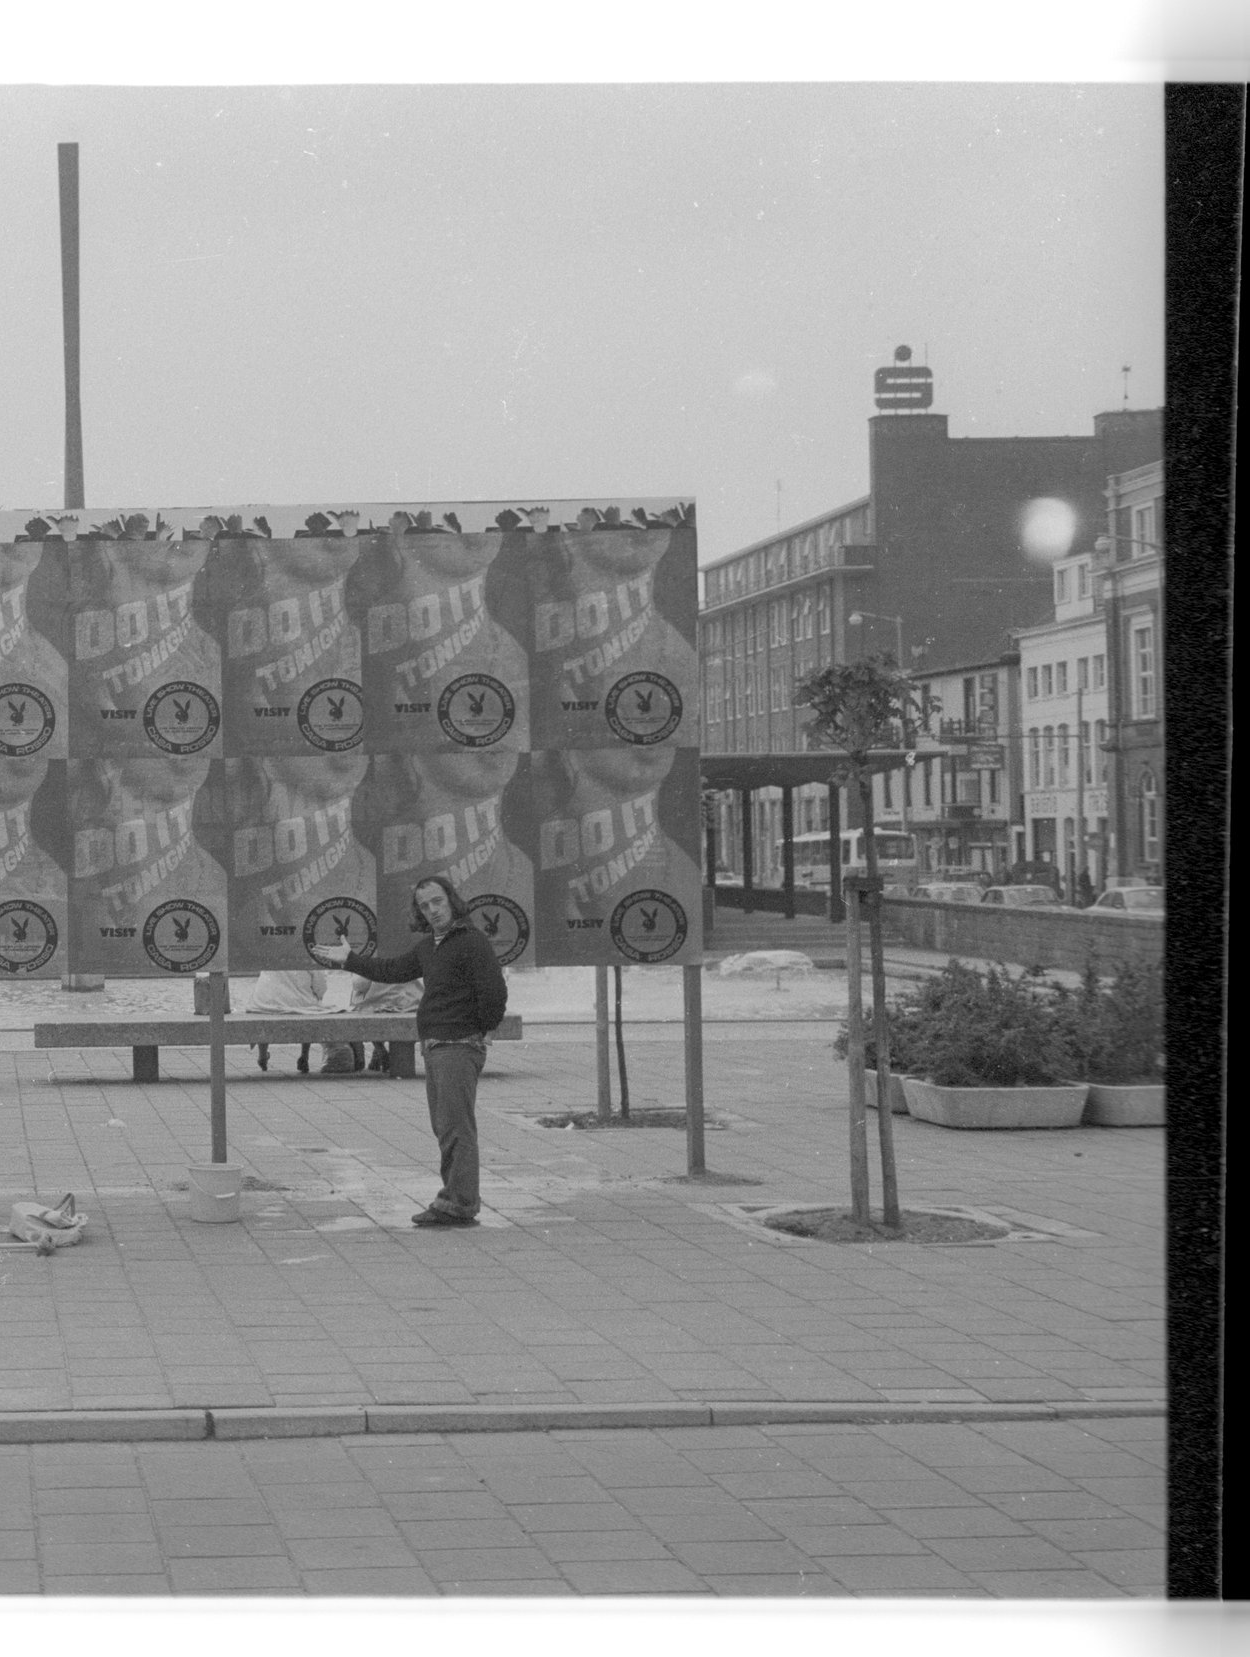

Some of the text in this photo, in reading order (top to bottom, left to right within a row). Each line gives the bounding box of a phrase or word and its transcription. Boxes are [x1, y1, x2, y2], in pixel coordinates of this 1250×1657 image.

[75, 582, 192, 660] DO IT
[228, 580, 344, 658] DO IT
[368, 576, 484, 654] DO IT
[534, 572, 653, 651] DO IT
[100, 709, 138, 720] VISIT
[254, 707, 291, 717] VISIT
[394, 703, 432, 714] VISIT
[562, 701, 599, 711] VISIT
[16, 728, 51, 754] ROSSO
[148, 726, 216, 752] CASA ROSSO
[302, 723, 326, 748] CASA
[442, 718, 510, 746] CASA ROSSO
[610, 716, 678, 742] CASA ROSSO
[75, 800, 192, 878] DO IT
[234, 798, 350, 876] DO IT
[383, 796, 500, 874] DO IT
[539, 790, 658, 869] DO IT
[449, 826, 500, 888] NIGHT
[99, 927, 137, 938] VISIT
[259, 925, 297, 936] VISIT
[566, 918, 604, 929] VISIT
[148, 944, 216, 970] CASA ROSSO
[498, 938, 526, 965] OSSO
[615, 934, 683, 960] CASA ROSSO
